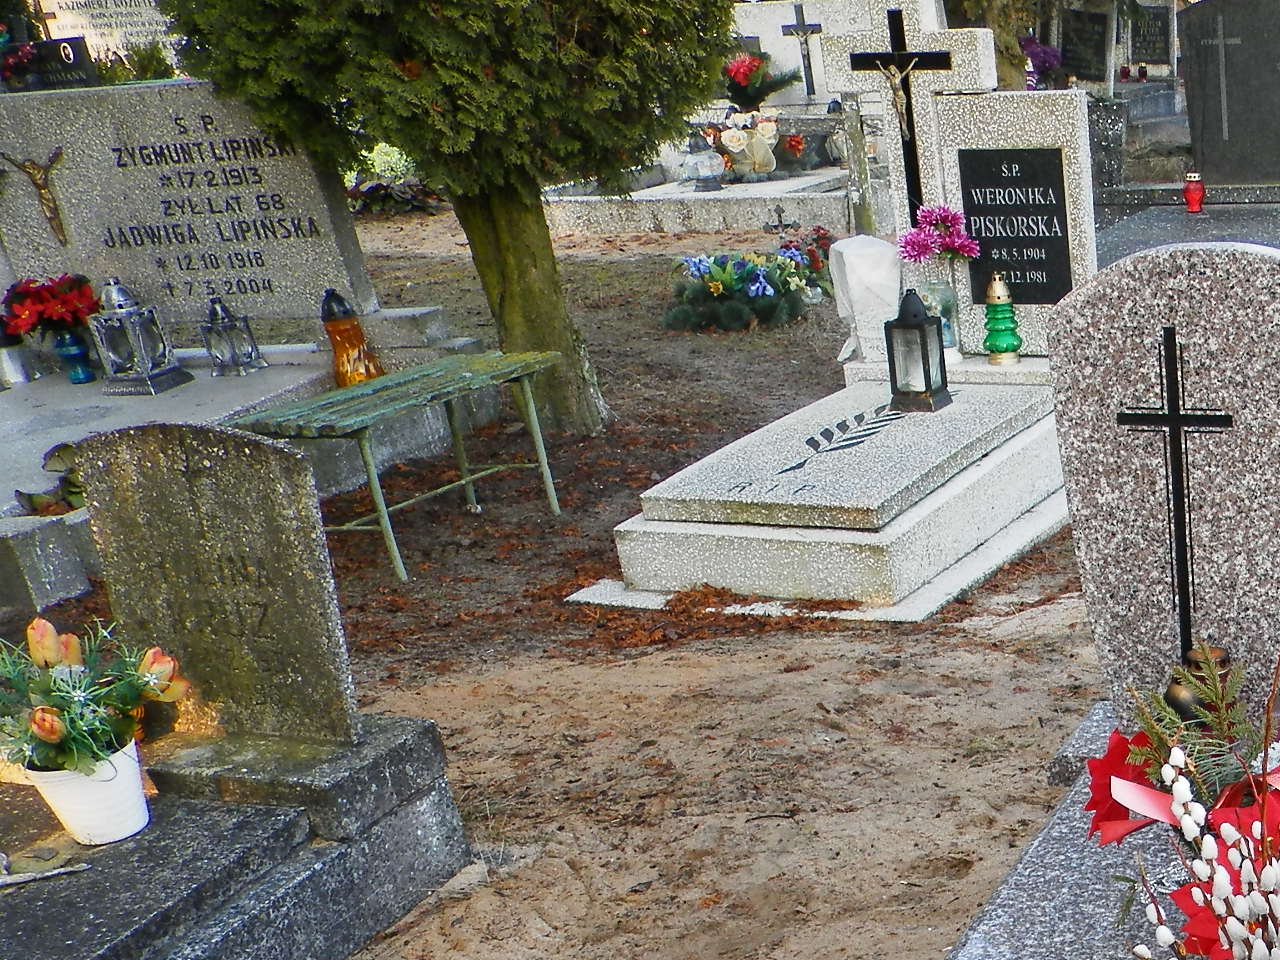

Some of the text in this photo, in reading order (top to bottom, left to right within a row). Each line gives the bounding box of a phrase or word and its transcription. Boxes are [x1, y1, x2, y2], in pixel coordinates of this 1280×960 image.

[112, 142, 206, 168] ZYGMUNT
[206, 195, 242, 214] LAT
[970, 187, 1057, 205] WERONIKA
[103, 223, 200, 249] JADWIGA
[970, 215, 1063, 238] PISKORSKA
